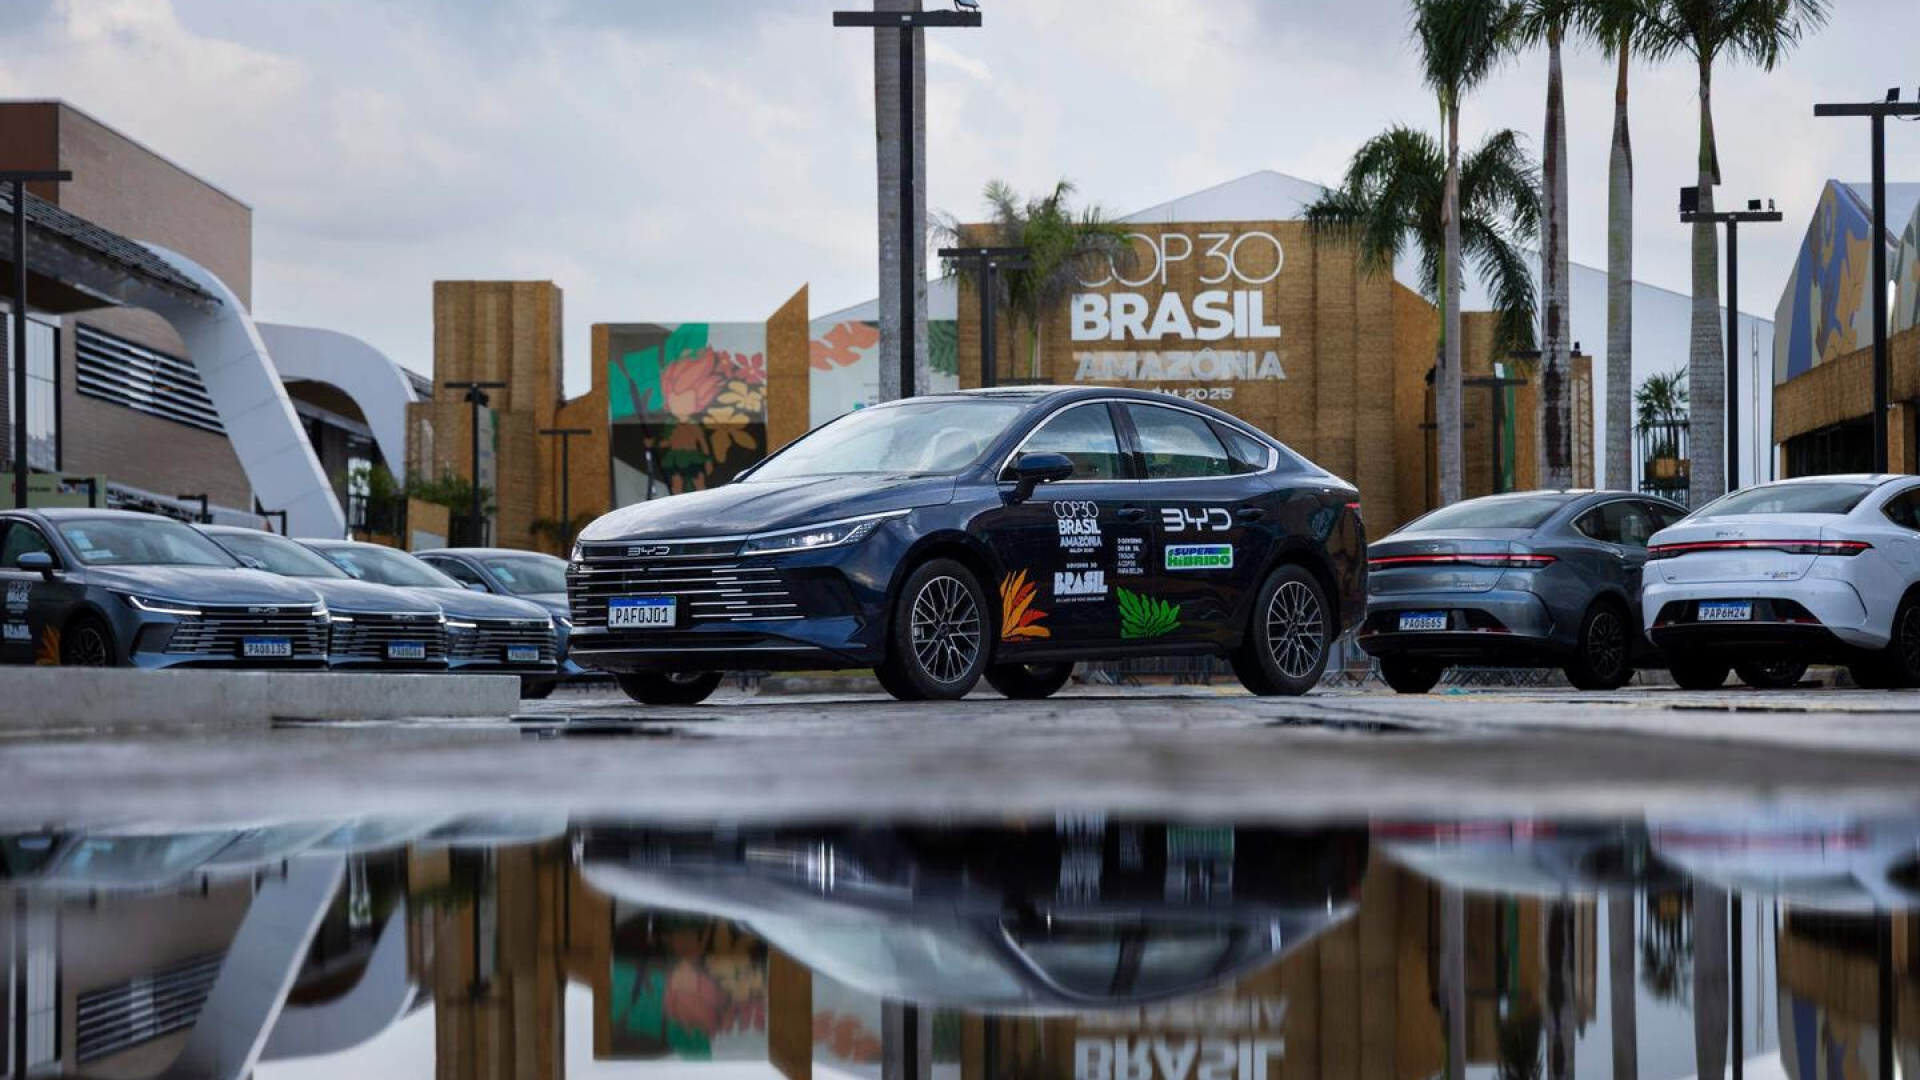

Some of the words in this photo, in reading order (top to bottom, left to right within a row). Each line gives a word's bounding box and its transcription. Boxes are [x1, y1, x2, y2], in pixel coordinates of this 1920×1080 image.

[1075, 231, 1192, 287] OP
[1071, 290, 1281, 341] BRASIL
[1073, 347, 1286, 381] AMAZÔNIA
[1185, 387, 1234, 400] 2025
[1057, 518, 1101, 535] BRASIL
[1161, 507, 1232, 532] BYD
[628, 546, 670, 557] BYD
[1054, 571, 1108, 595] BRASIL
